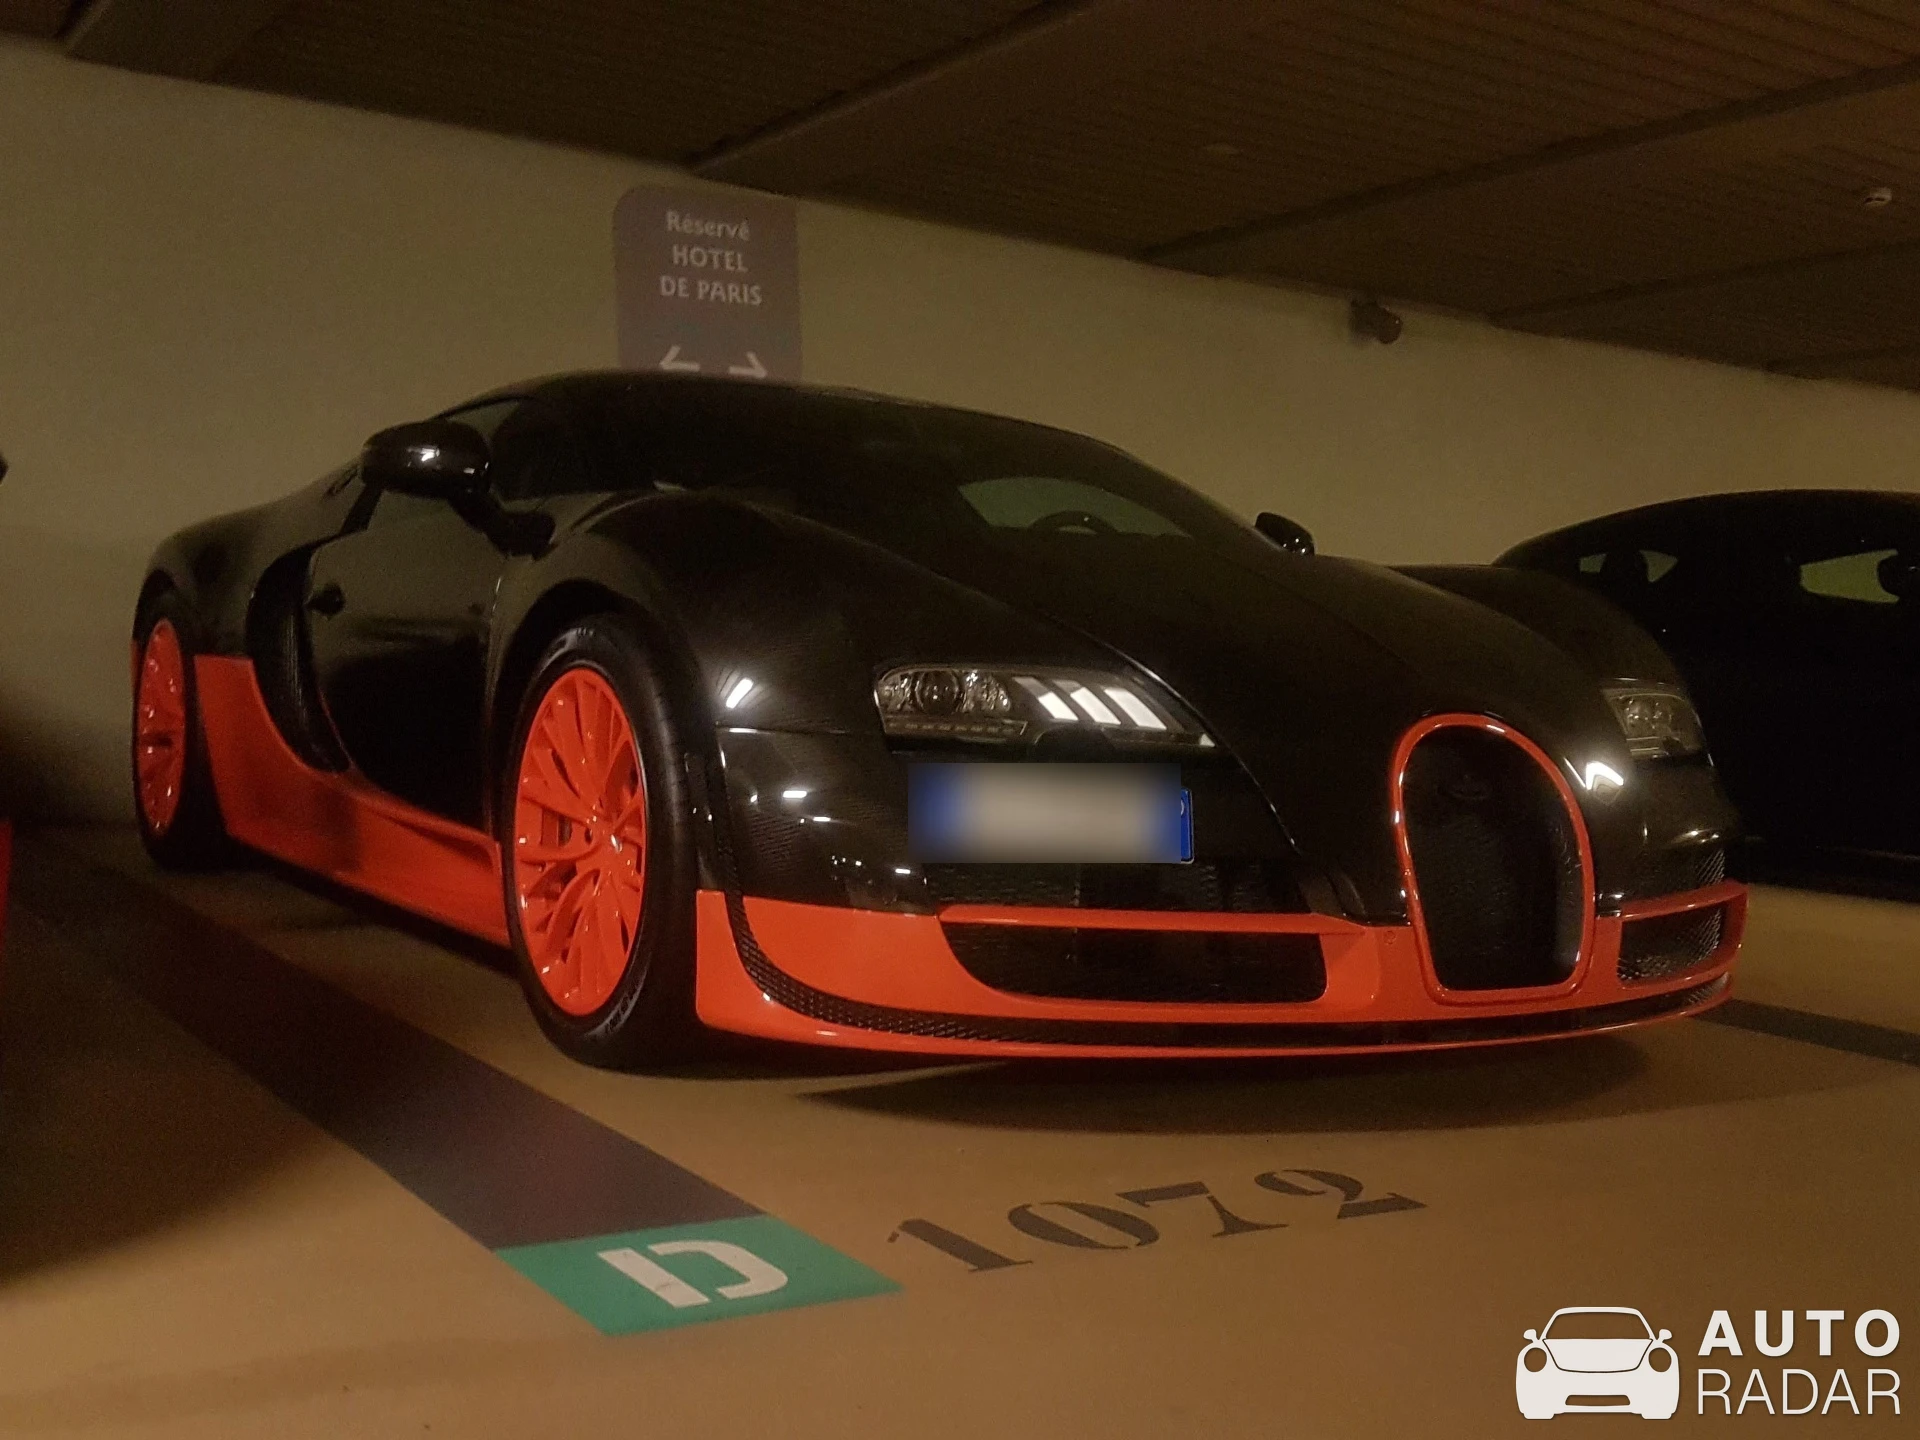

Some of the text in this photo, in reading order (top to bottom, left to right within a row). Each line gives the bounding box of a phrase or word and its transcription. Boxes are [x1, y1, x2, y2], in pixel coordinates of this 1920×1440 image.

[666, 209, 751, 241] Réservé
[672, 244, 748, 273] HOTEL
[659, 275, 763, 306] DE PARIS
[887, 1168, 1428, 1272] 1072
